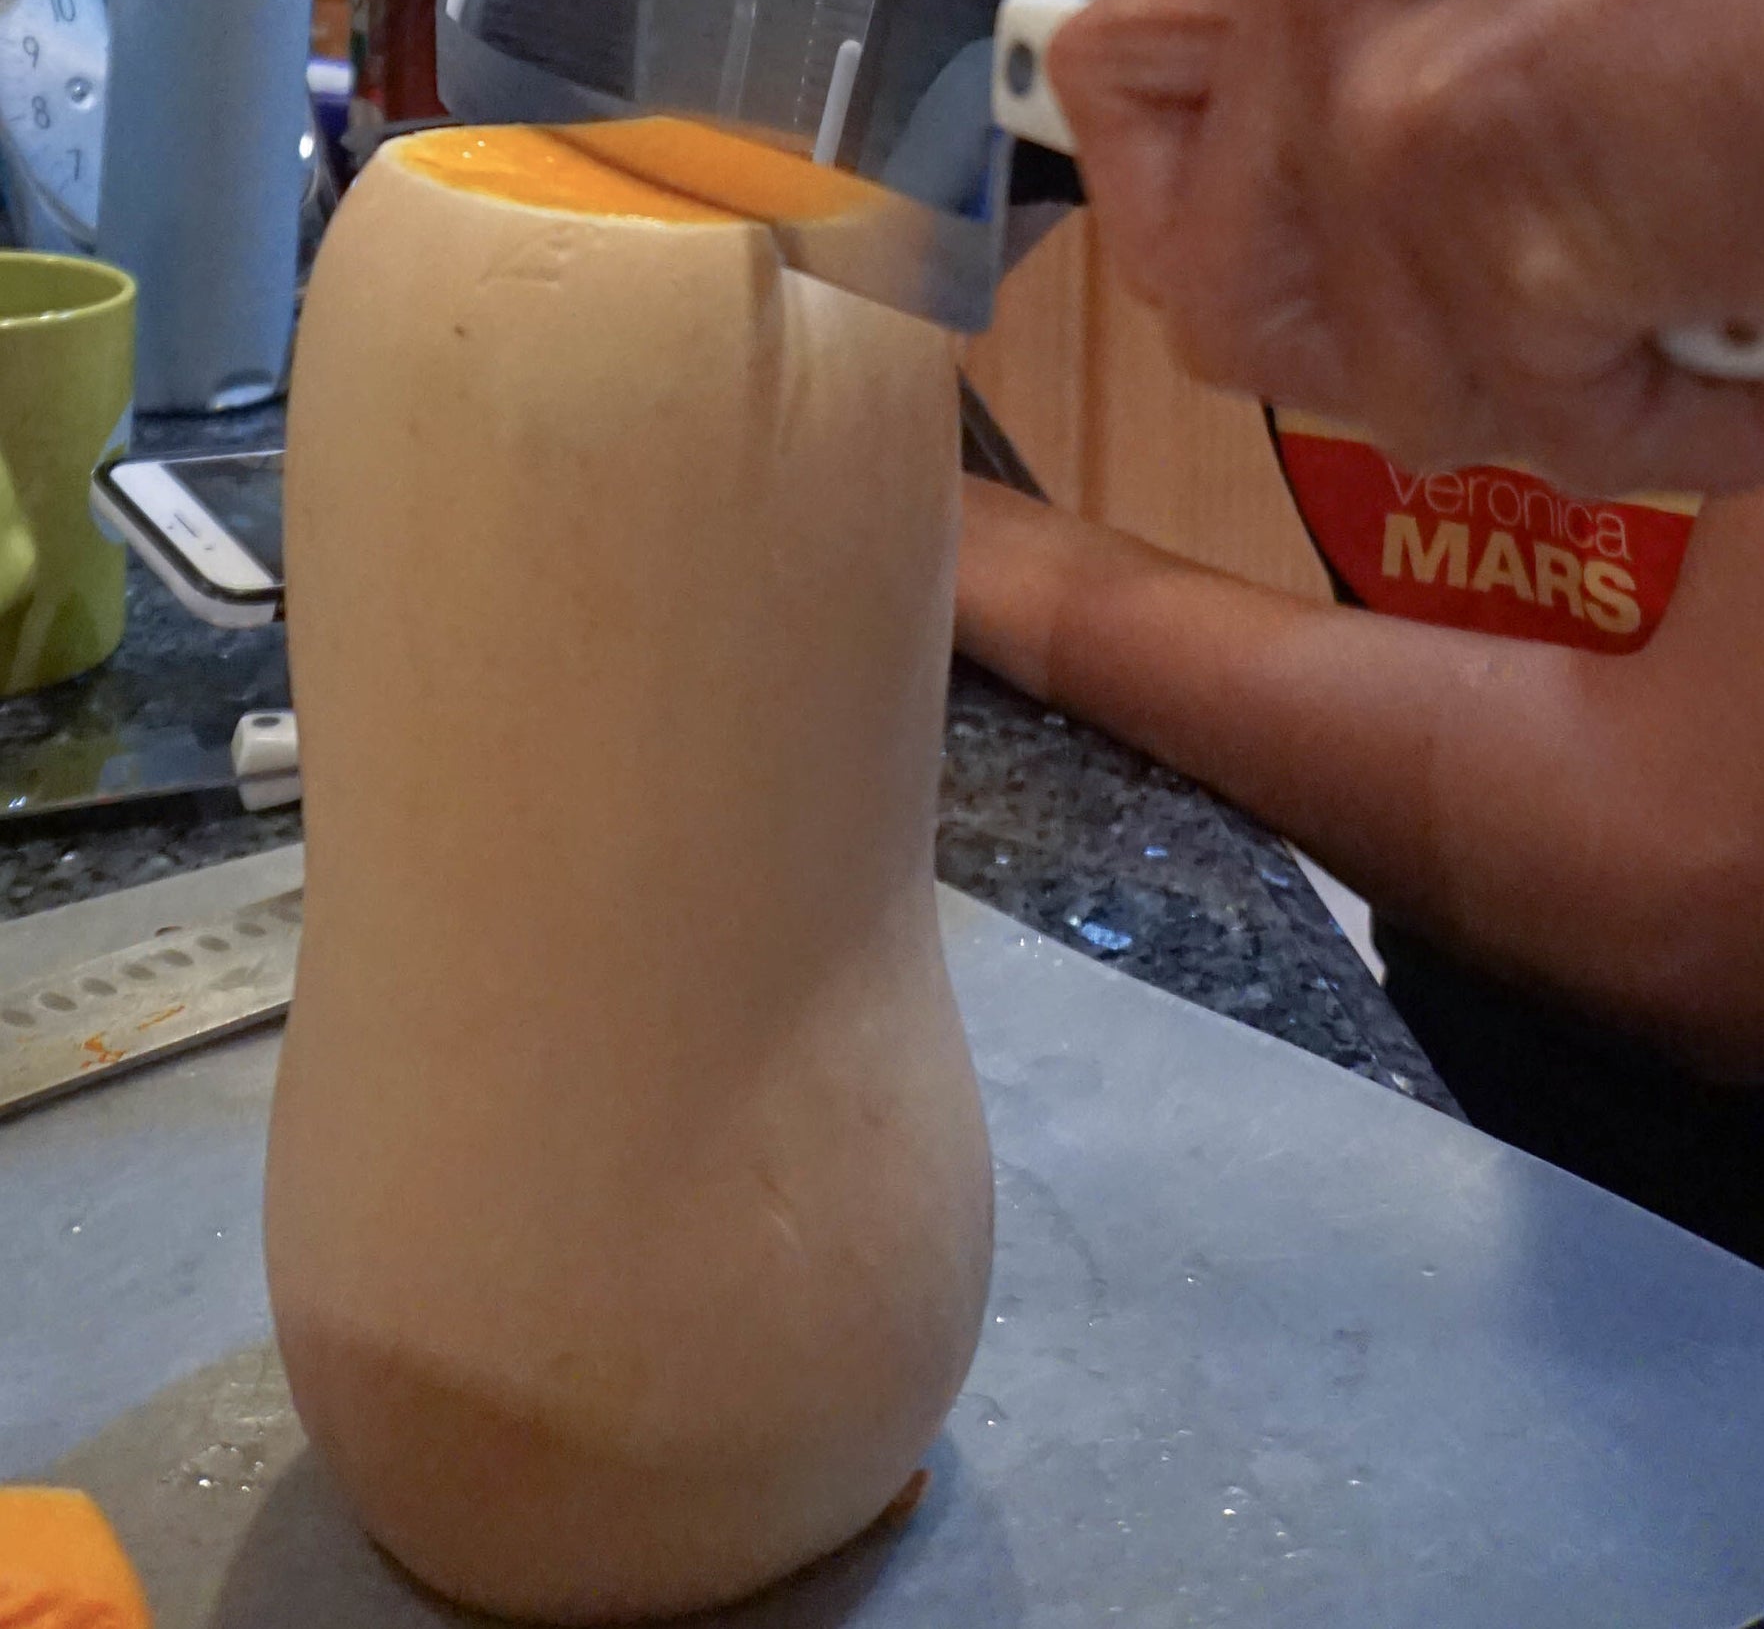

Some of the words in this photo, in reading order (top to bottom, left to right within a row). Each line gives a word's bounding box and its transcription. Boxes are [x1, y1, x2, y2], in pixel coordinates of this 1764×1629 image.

[22, 35, 40, 68] 9
[31, 95, 50, 130] 8
[66, 147, 82, 182] 7
[1387, 461, 1632, 561] veronica
[1381, 512, 1642, 634] MARS
